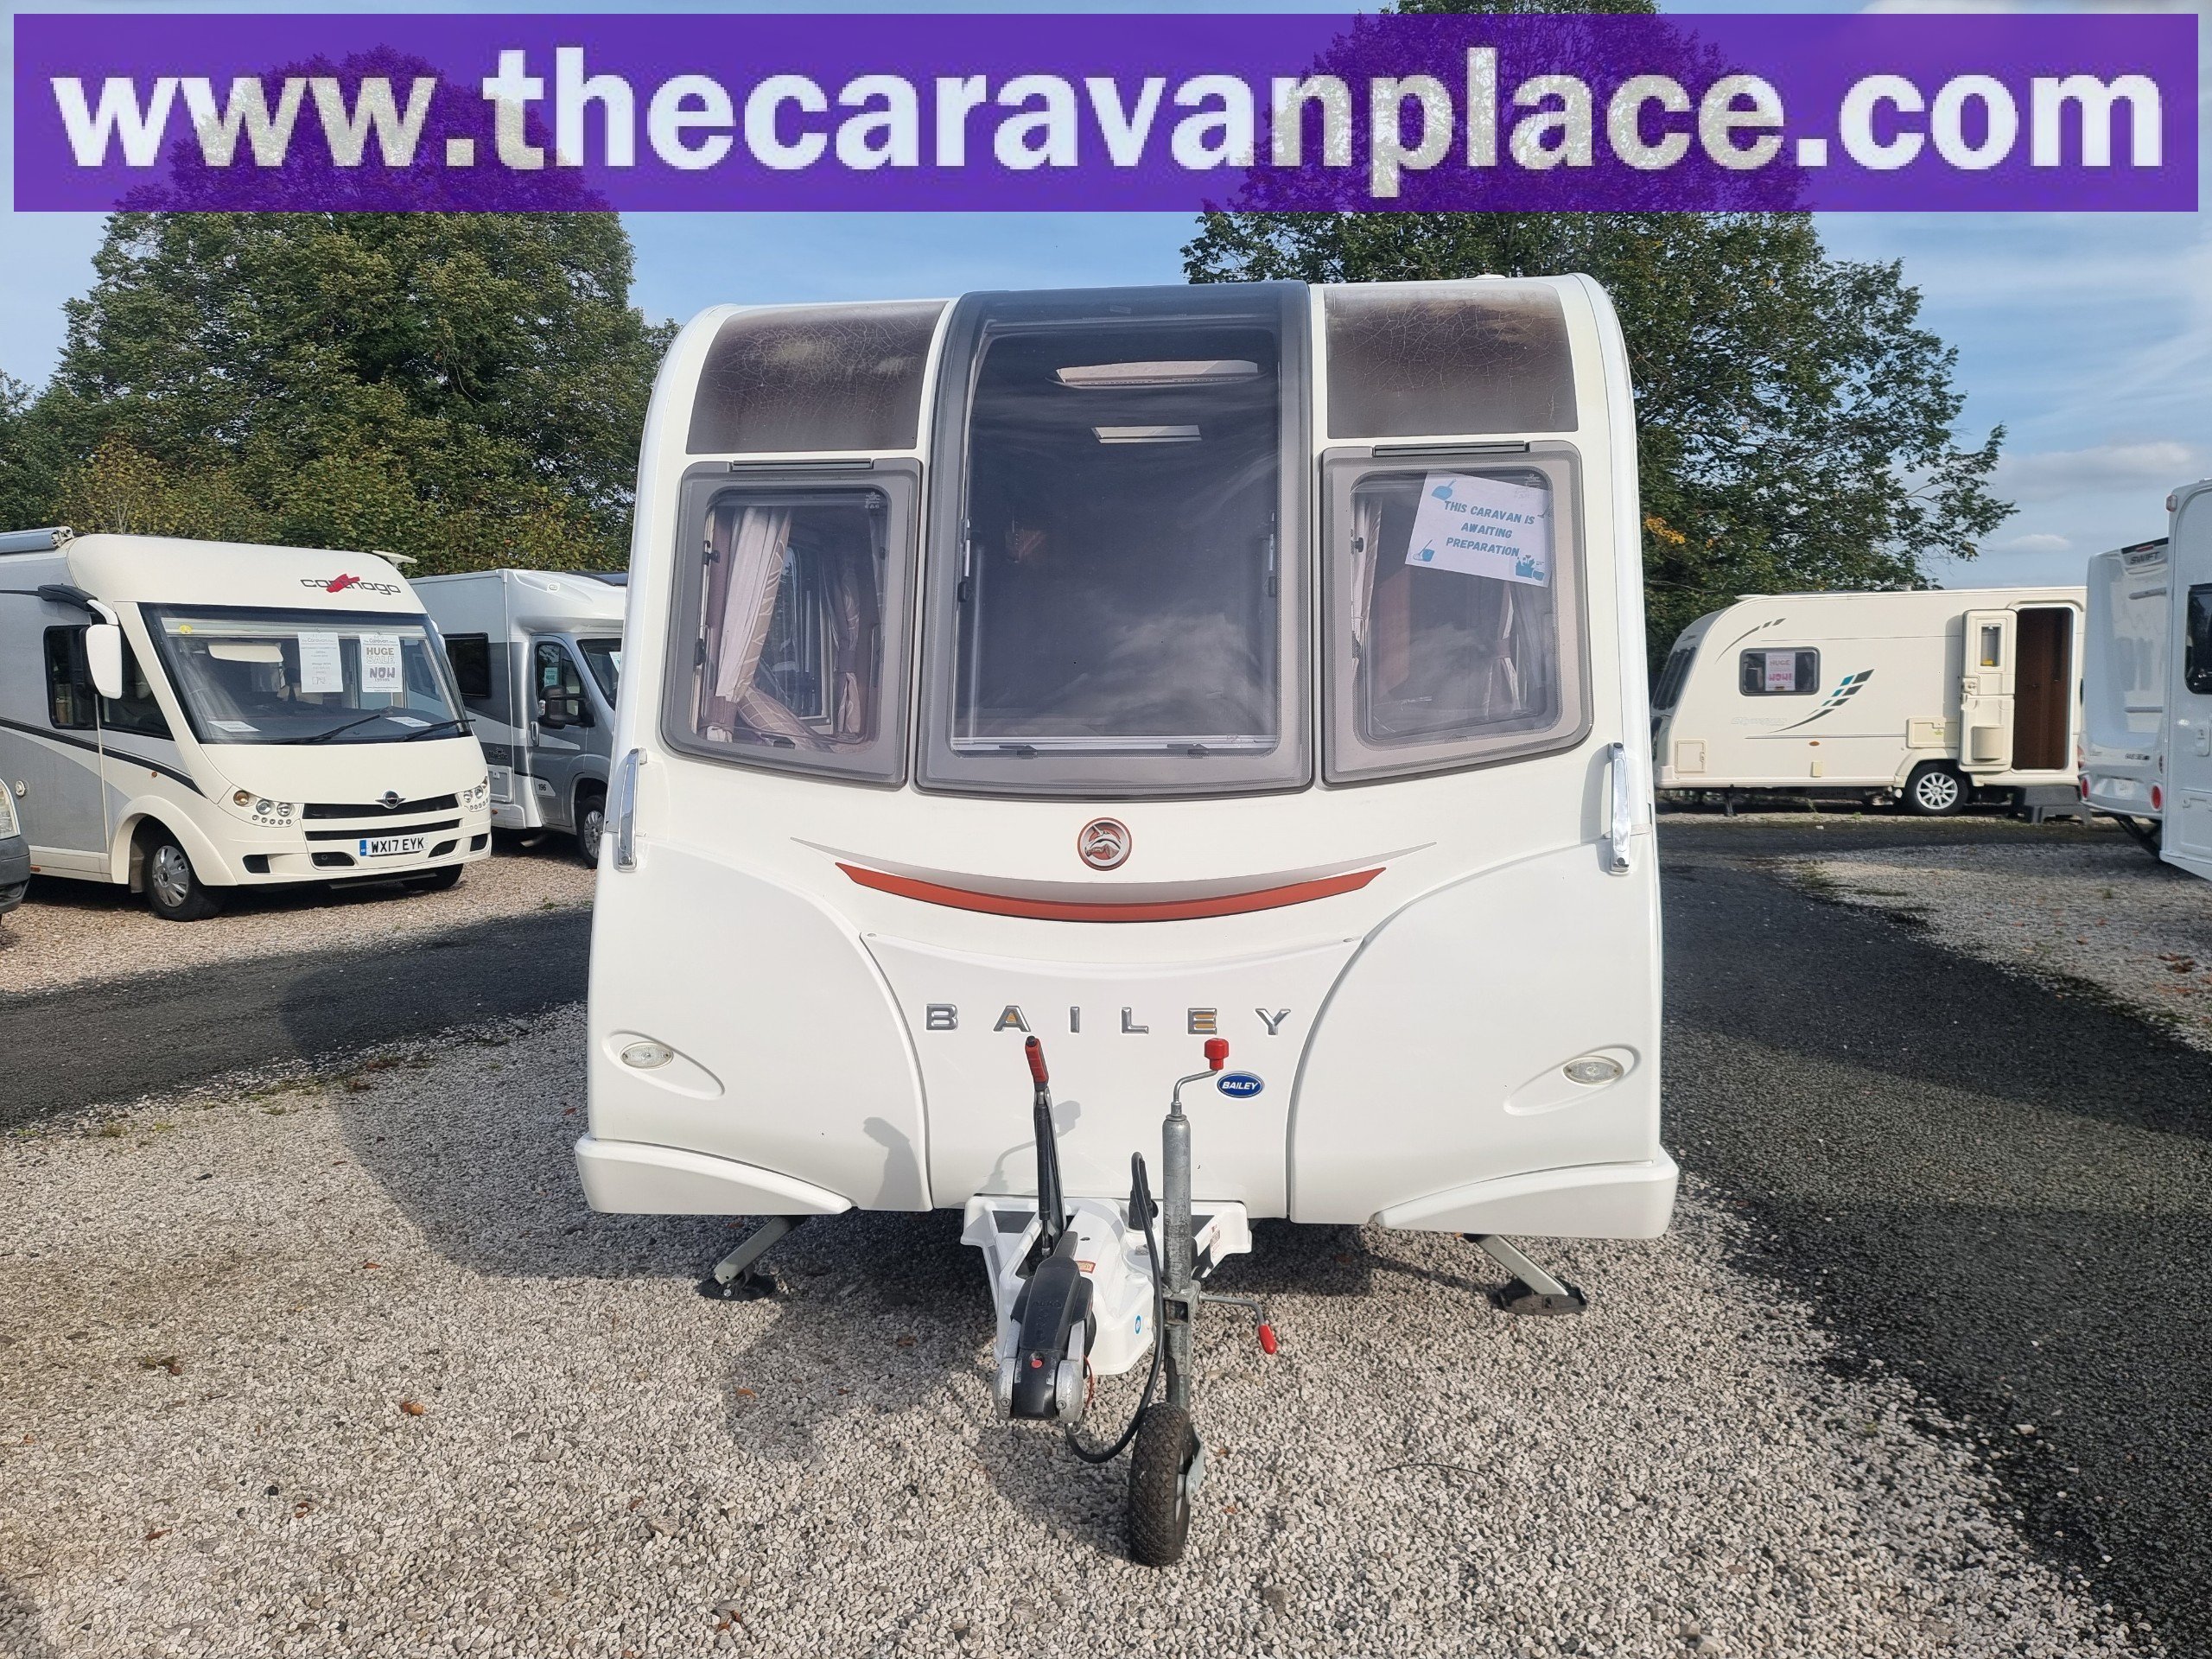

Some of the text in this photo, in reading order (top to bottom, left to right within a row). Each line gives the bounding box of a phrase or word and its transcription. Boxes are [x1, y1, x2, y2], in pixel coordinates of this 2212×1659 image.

[1444, 500, 1535, 525] THIS CARAVAN IS
[1461, 522, 1513, 539] AWAITING
[1446, 537, 1520, 557] PREPARATION
[2130, 551, 2160, 564] SWIFT
[300, 576, 401, 595] cahago
[366, 647, 394, 656] HUGE
[366, 656, 395, 664] SALE
[369, 667, 395, 678] NOW
[538, 783, 547, 791] 196
[372, 837, 424, 853] WX17 EYK
[925, 1003, 1292, 1036] BAILEY
[1222, 1081, 1259, 1090] BAILEY
